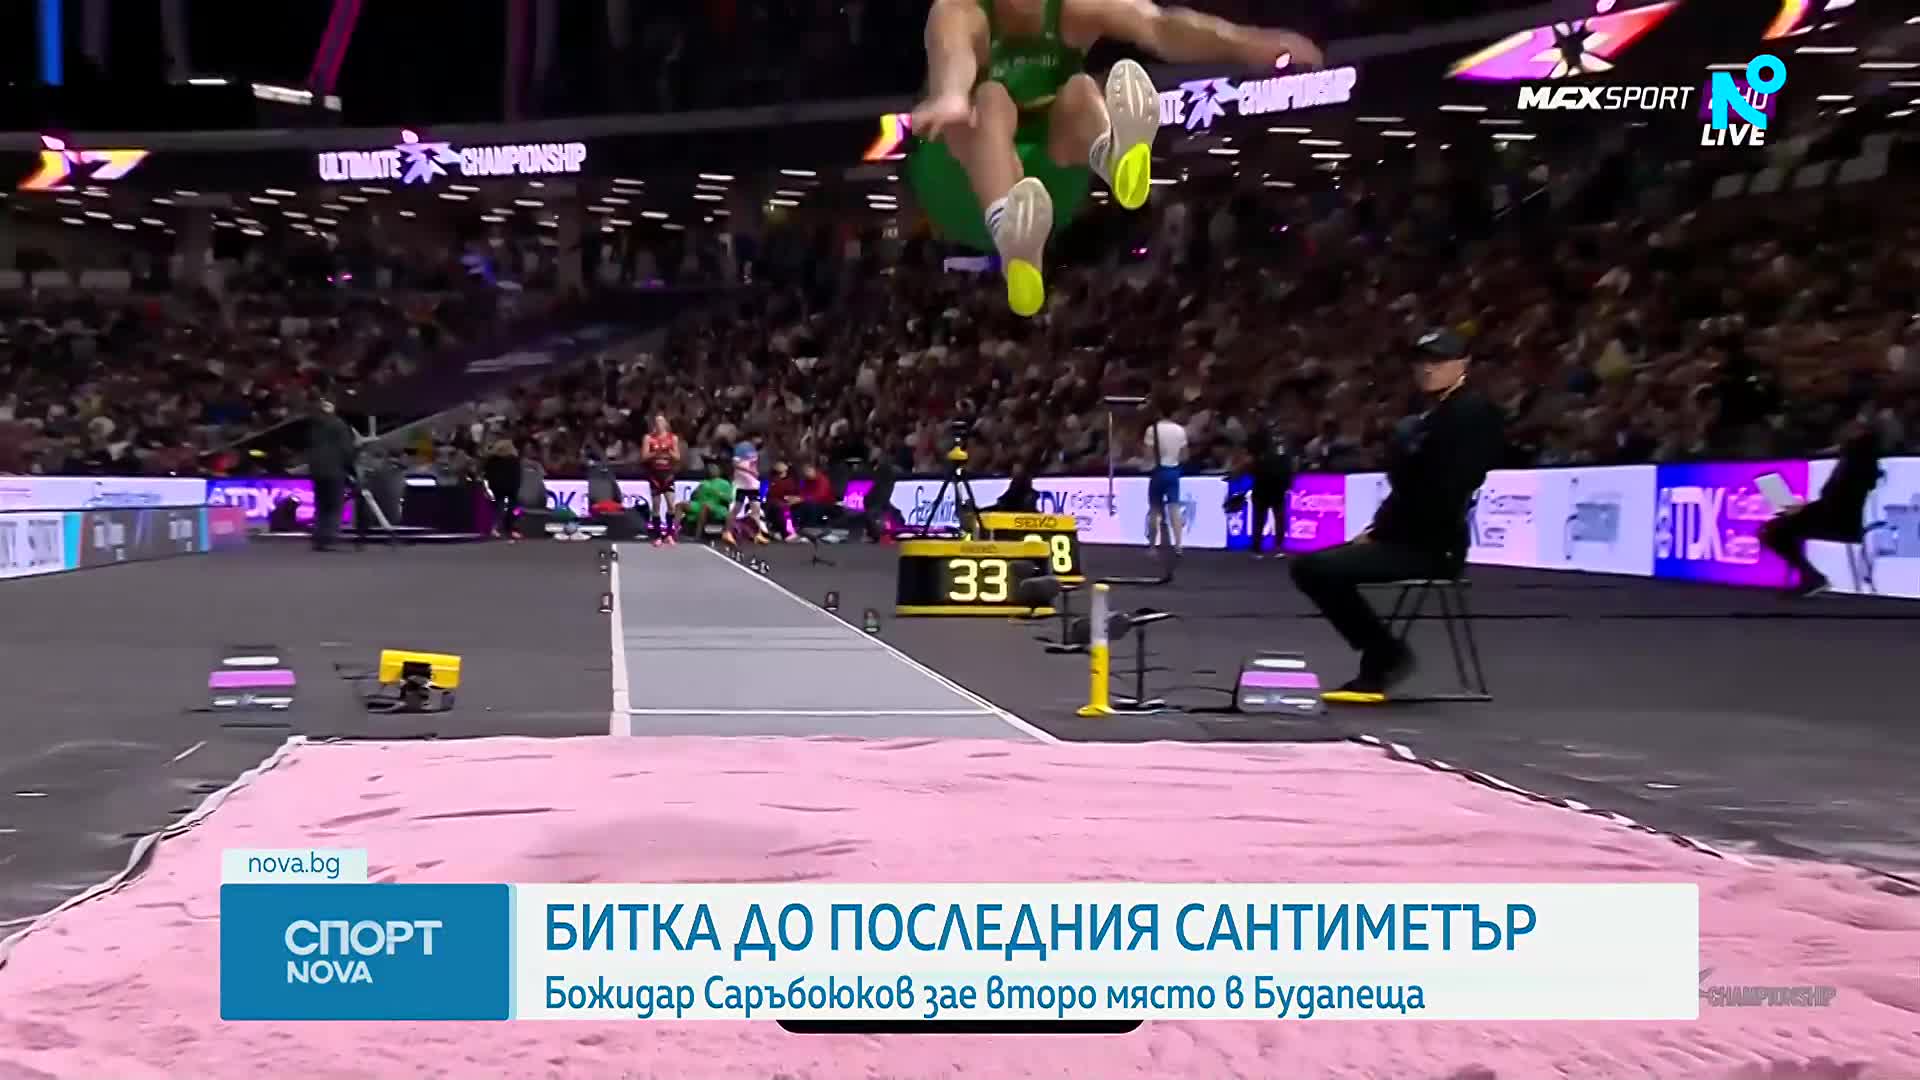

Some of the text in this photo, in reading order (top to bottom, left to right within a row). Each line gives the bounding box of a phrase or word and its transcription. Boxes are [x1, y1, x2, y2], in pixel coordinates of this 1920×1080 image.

[318, 143, 586, 181] ULTIMATE CHAMPIONSHIP
[949, 558, 1008, 602] 33
